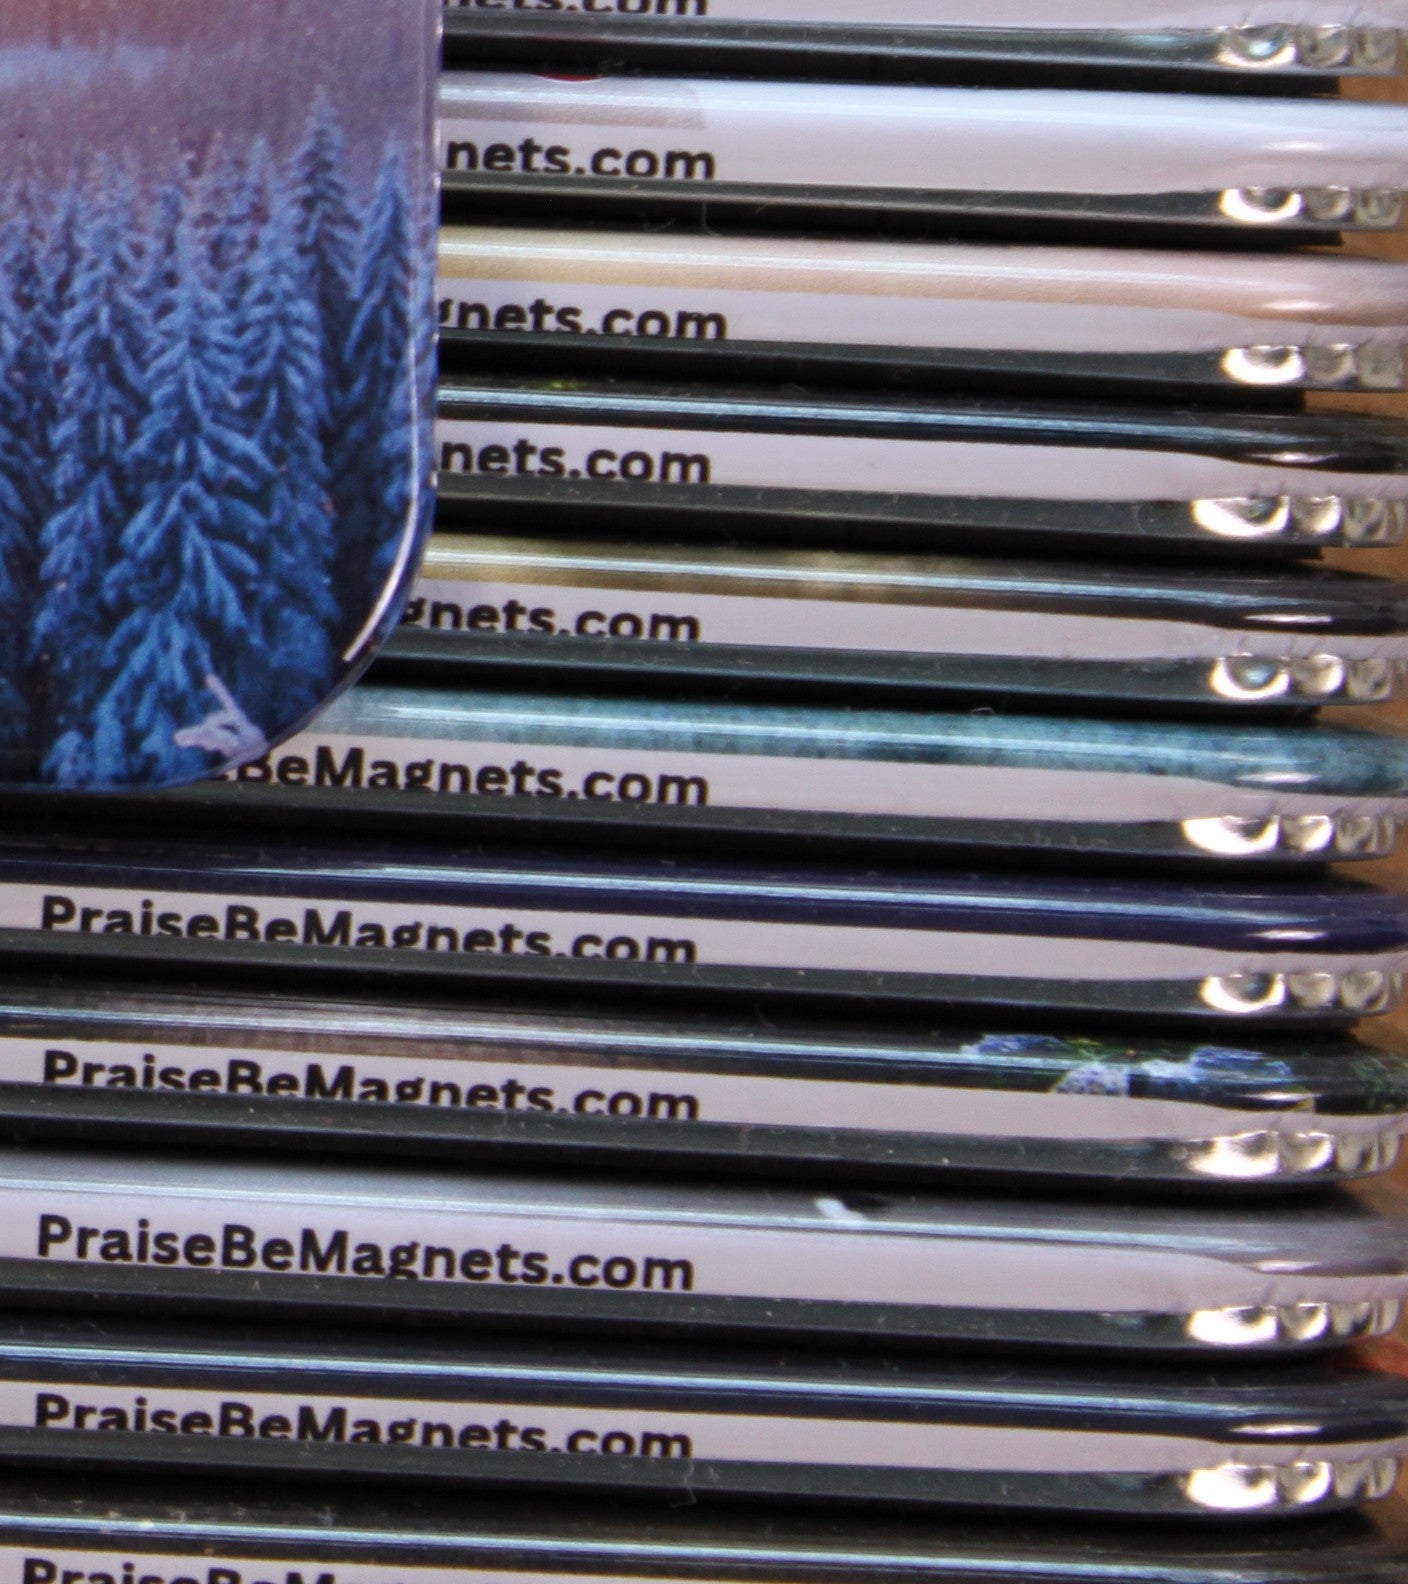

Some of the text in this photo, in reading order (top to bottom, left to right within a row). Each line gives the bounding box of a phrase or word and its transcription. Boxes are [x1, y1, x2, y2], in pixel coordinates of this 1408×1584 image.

[224, 744, 709, 806] BeMagnets.com
[41, 895, 697, 963] PraiseBeMagnets.com
[43, 1050, 699, 1121] PraiseBeMagnets.com
[37, 1214, 694, 1291] PraiseBeMagnets.com
[35, 1393, 692, 1458] PraiseBeMagnets.com
